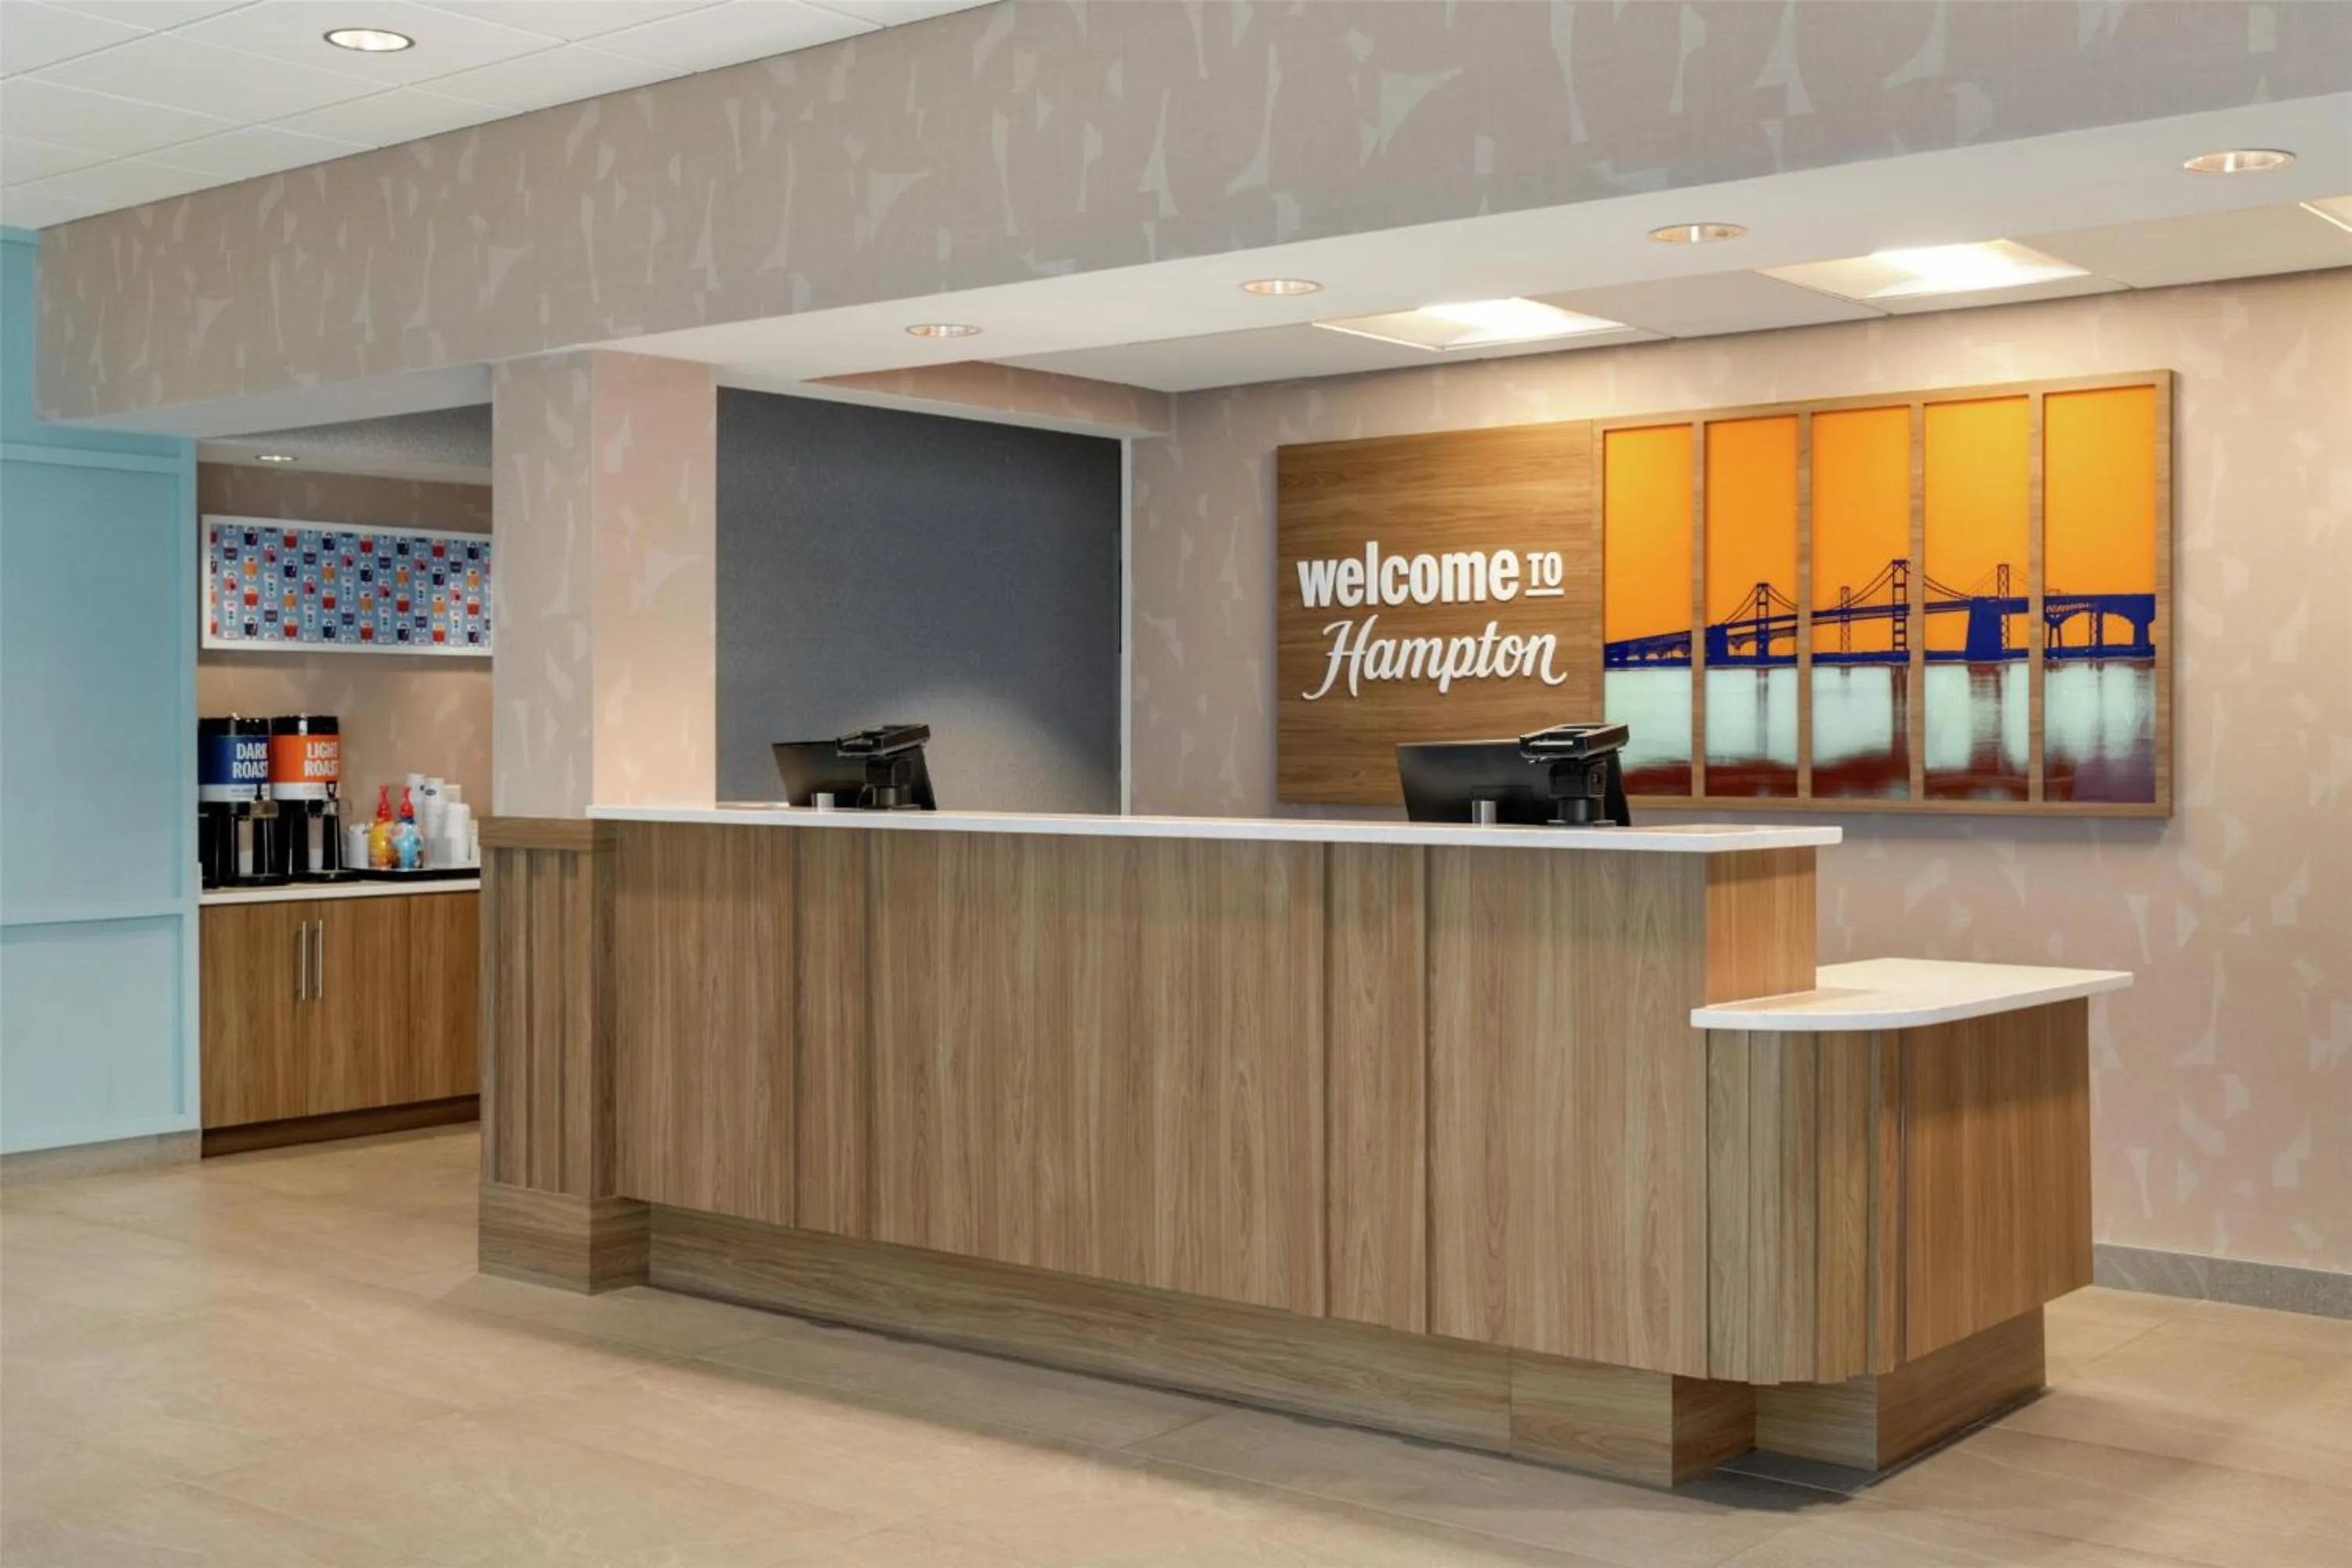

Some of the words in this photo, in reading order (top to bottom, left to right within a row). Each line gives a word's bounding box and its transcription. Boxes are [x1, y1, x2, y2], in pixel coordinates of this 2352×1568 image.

[1296, 540, 1520, 608] welcome
[1526, 551, 1563, 588] TO
[1301, 614, 1568, 701] Hampton
[236, 742, 267, 760] DARK
[307, 741, 338, 759] LIGHT
[232, 760, 268, 779] ROAST
